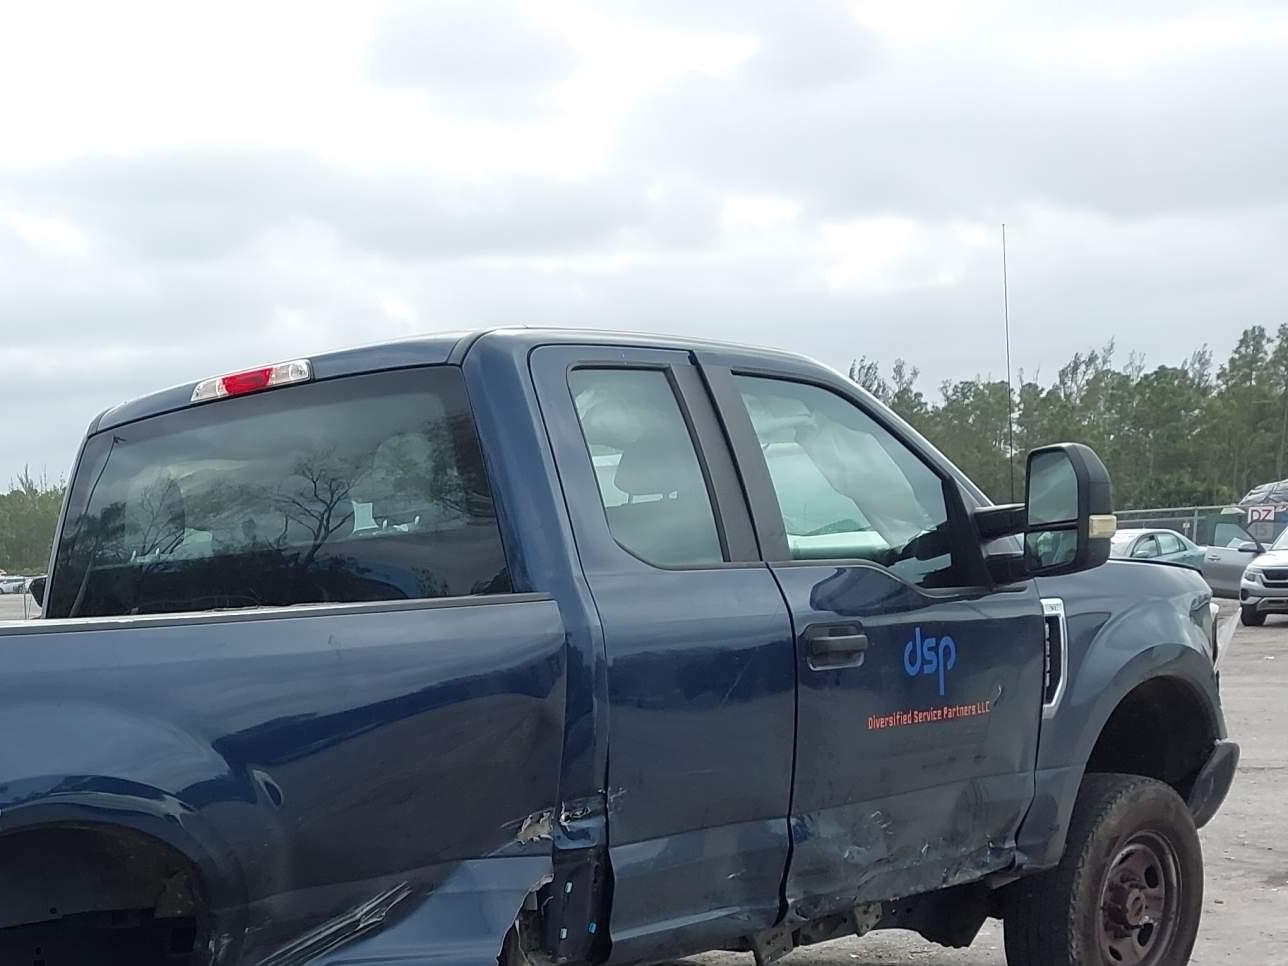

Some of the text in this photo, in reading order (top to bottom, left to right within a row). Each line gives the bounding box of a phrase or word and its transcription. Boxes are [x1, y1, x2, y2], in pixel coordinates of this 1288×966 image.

[903, 627, 956, 695] dsp
[914, 707, 942, 723] Service
[943, 704, 976, 719] Partners
[977, 701, 990, 714] LLC
